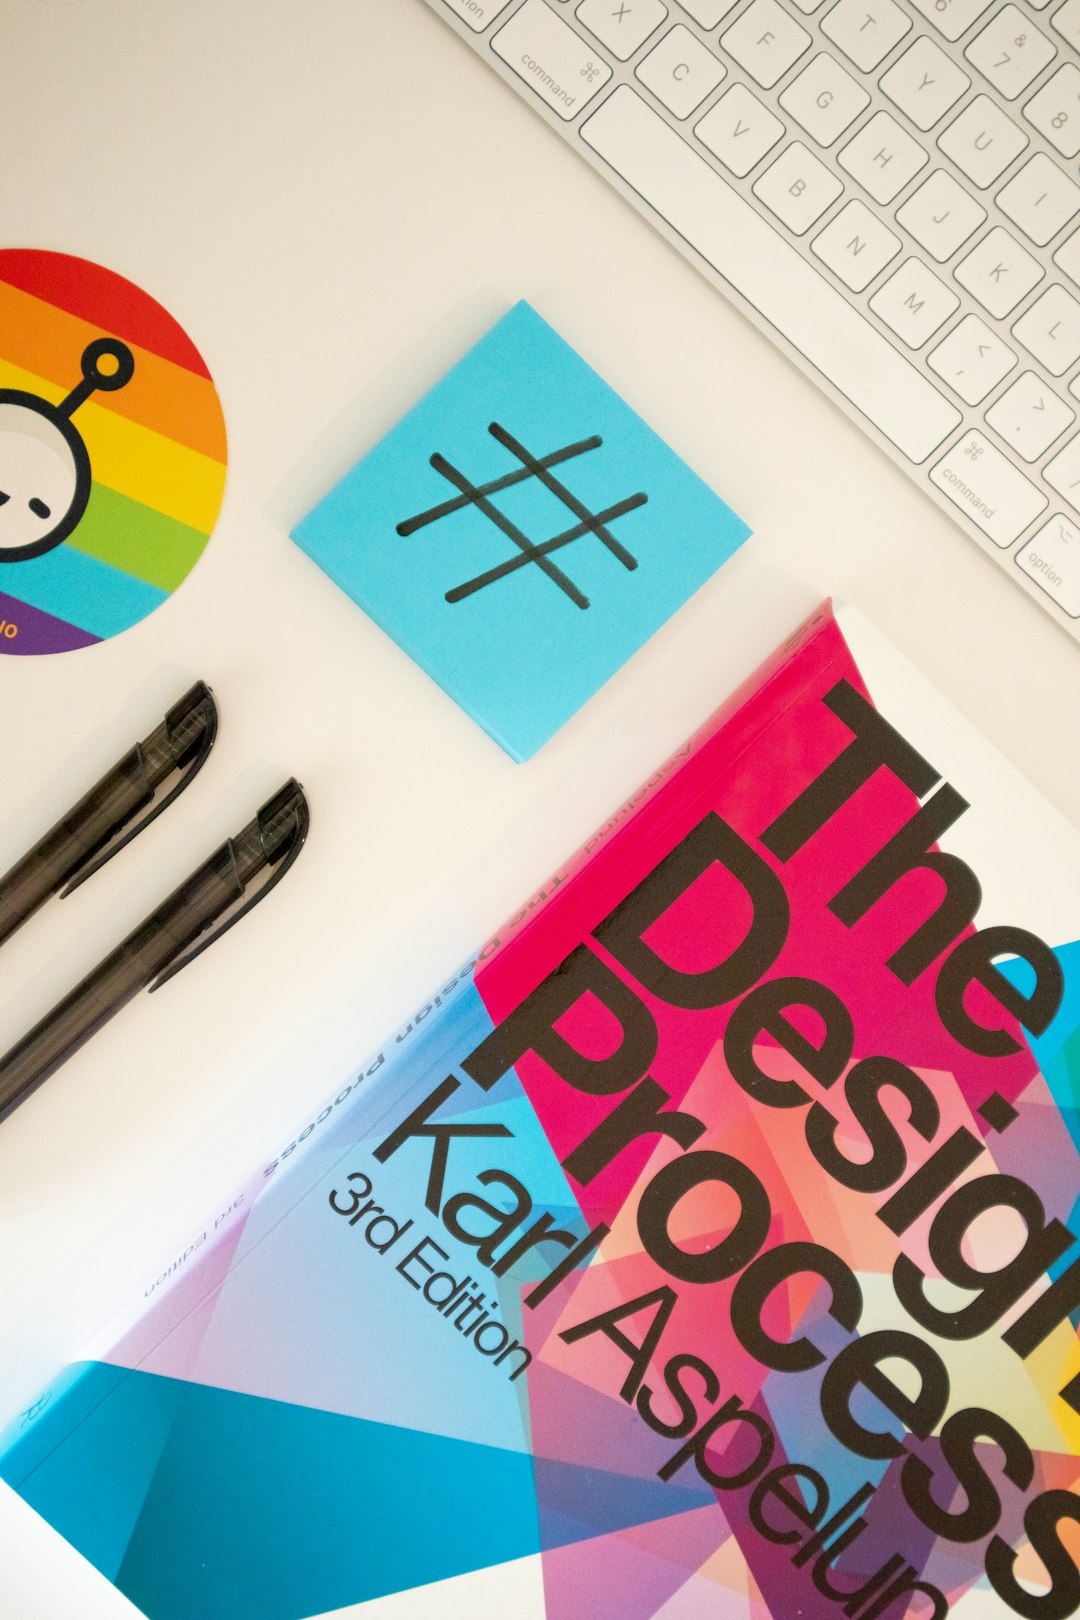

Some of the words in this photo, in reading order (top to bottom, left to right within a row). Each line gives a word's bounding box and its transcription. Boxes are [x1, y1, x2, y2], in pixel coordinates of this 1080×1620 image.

[611, 2, 632, 23] X
[859, 14, 877, 32] T
[756, 31, 776, 45] F
[1014, 33, 1027, 49] &
[993, 52, 1012, 68] 7
[521, 54, 576, 107] command
[672, 63, 690, 82] C
[918, 72, 935, 91] Y
[816, 90, 834, 109] G
[732, 119, 751, 138] V
[1051, 111, 1069, 130] 8
[974, 130, 993, 151] U
[872, 147, 893, 169] H
[788, 178, 807, 198] B
[932, 211, 951, 224] J
[846, 235, 866, 257] N
[989, 263, 1009, 283] K
[903, 292, 926, 315] M
[1048, 321, 1062, 340] L
[942, 468, 996, 519] command
[1028, 552, 1063, 587] option
[584, 742, 692, 854] Aspelund
[758, 678, 1064, 1058] The
[509, 870, 570, 928] The
[395, 935, 502, 1045] Design
[262, 1051, 386, 1179] Process
[372, 1074, 612, 1311] Karl
[213, 1193, 245, 1233] 3rd
[143, 1230, 208, 1299] Edition
[328, 1172, 415, 1256] 3rd
[395, 1236, 533, 1383] Edition
